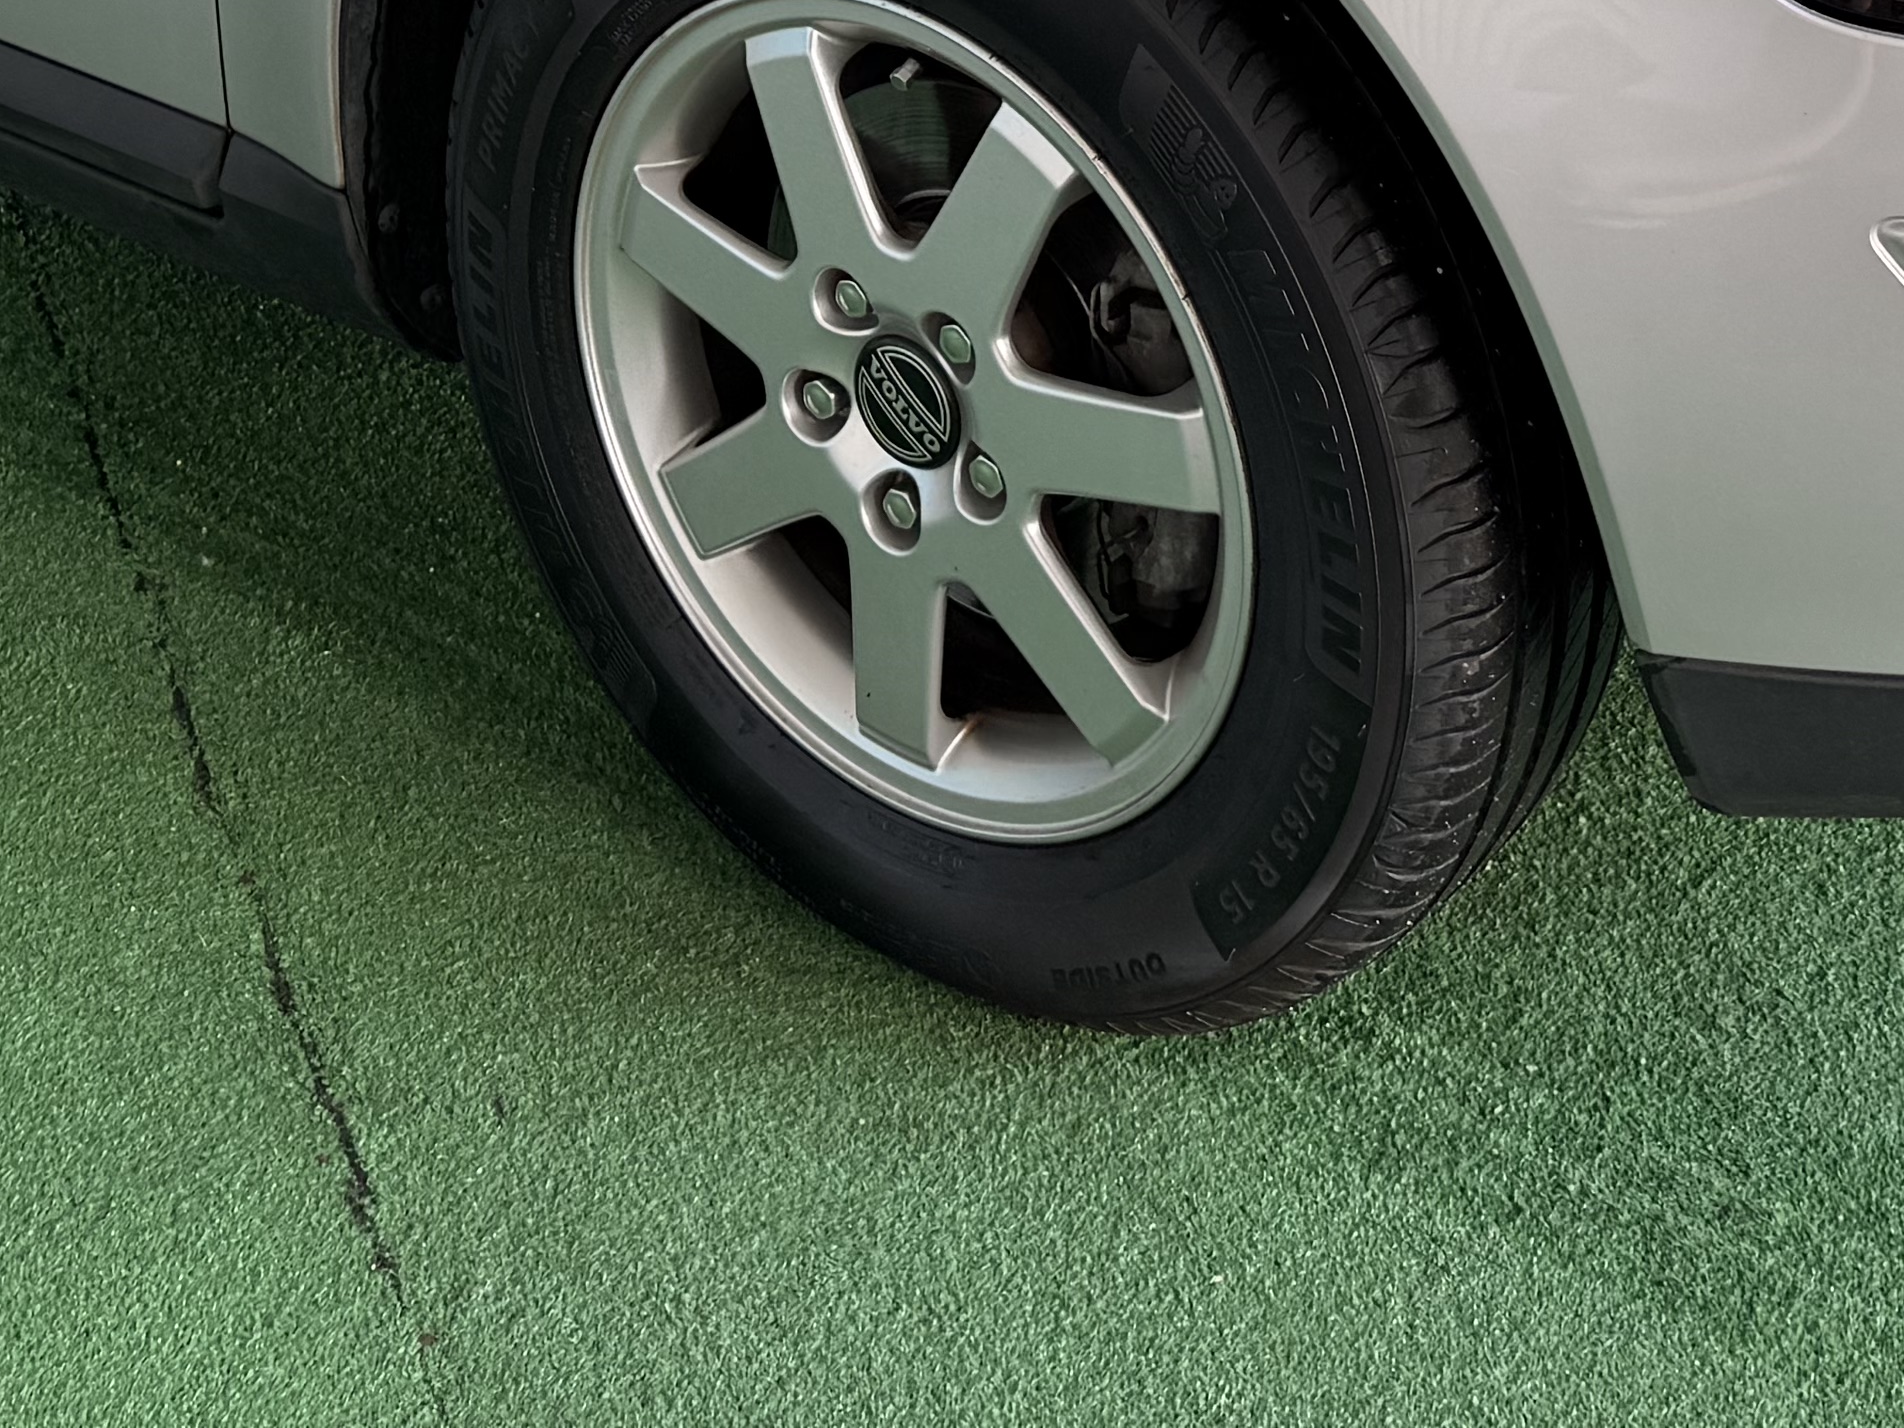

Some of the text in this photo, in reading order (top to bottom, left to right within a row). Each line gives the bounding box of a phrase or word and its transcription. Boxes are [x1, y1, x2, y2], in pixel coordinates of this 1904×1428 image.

[870, 353, 941, 454] VOLVO
[1227, 246, 1364, 678] MICHELIN
[1217, 724, 1342, 925] 195/65 R 15
